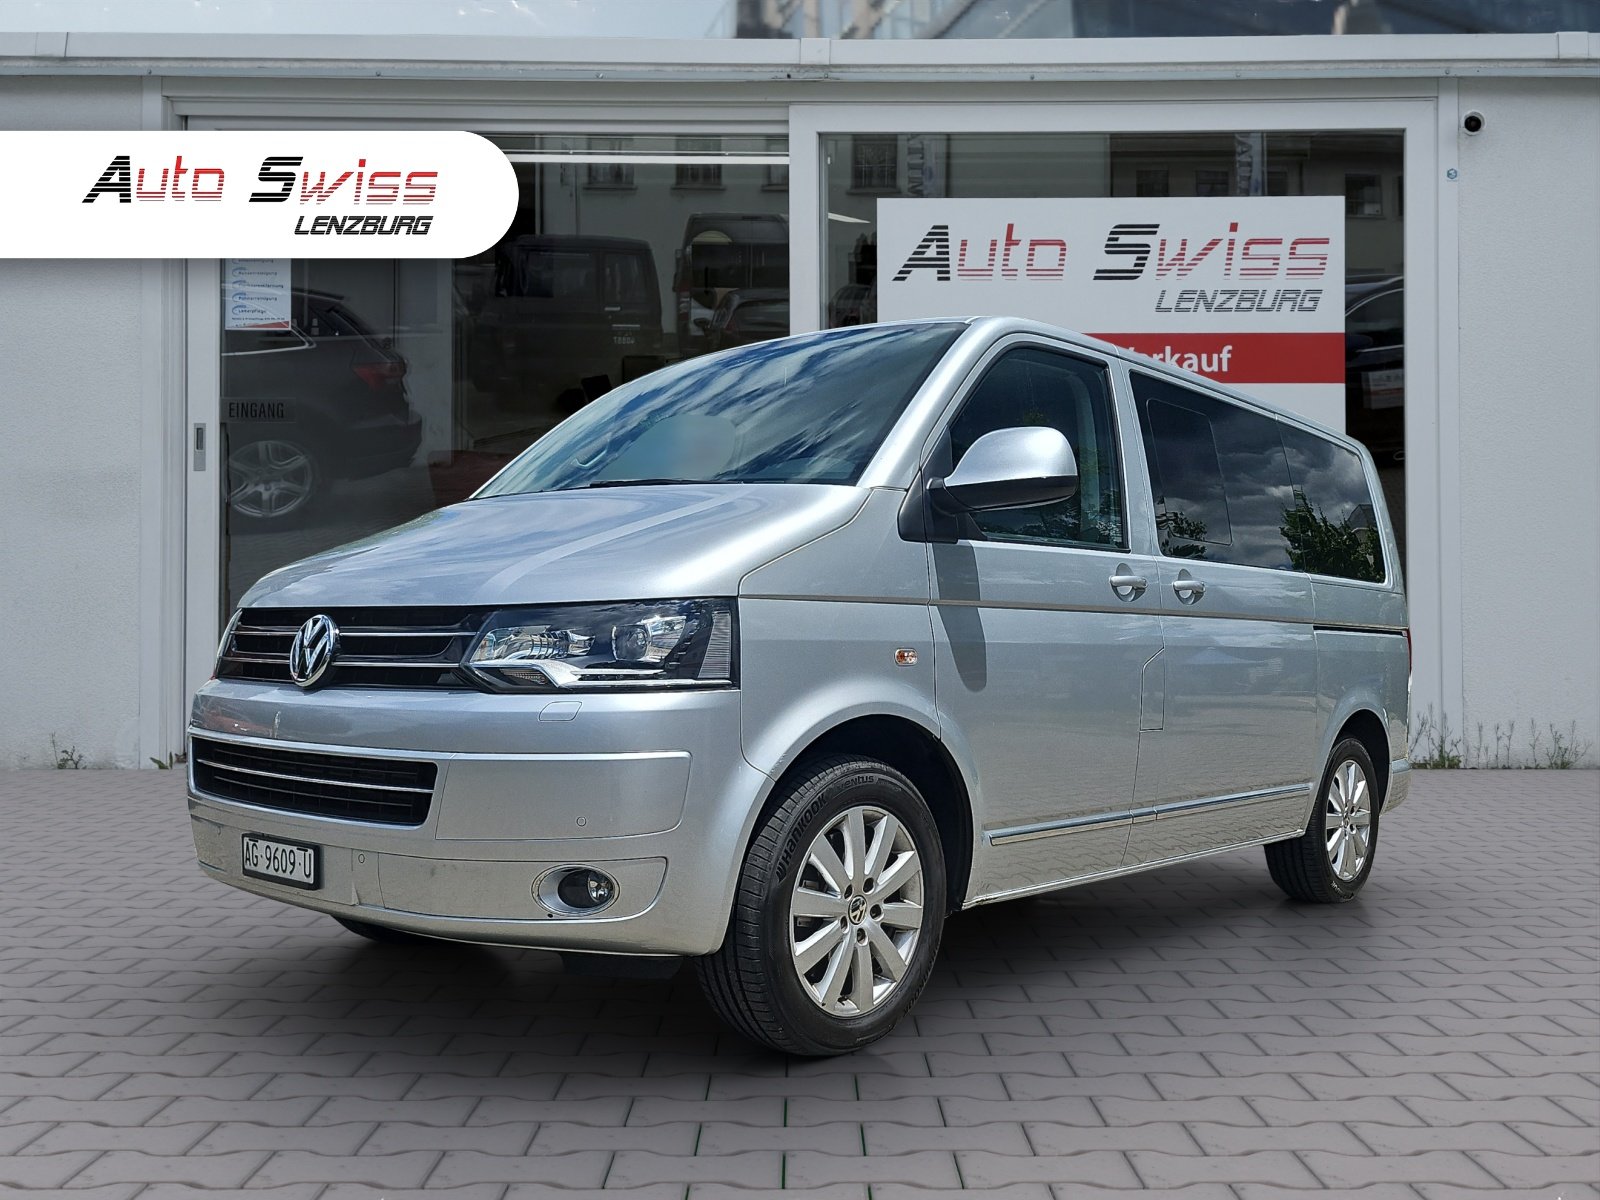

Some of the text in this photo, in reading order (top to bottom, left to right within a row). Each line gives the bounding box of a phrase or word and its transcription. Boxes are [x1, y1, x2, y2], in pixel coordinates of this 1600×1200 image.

[891, 222, 1330, 282] Auto Swiss
[1155, 289, 1323, 312] LENZBURG
[228, 402, 284, 419] EINGANG
